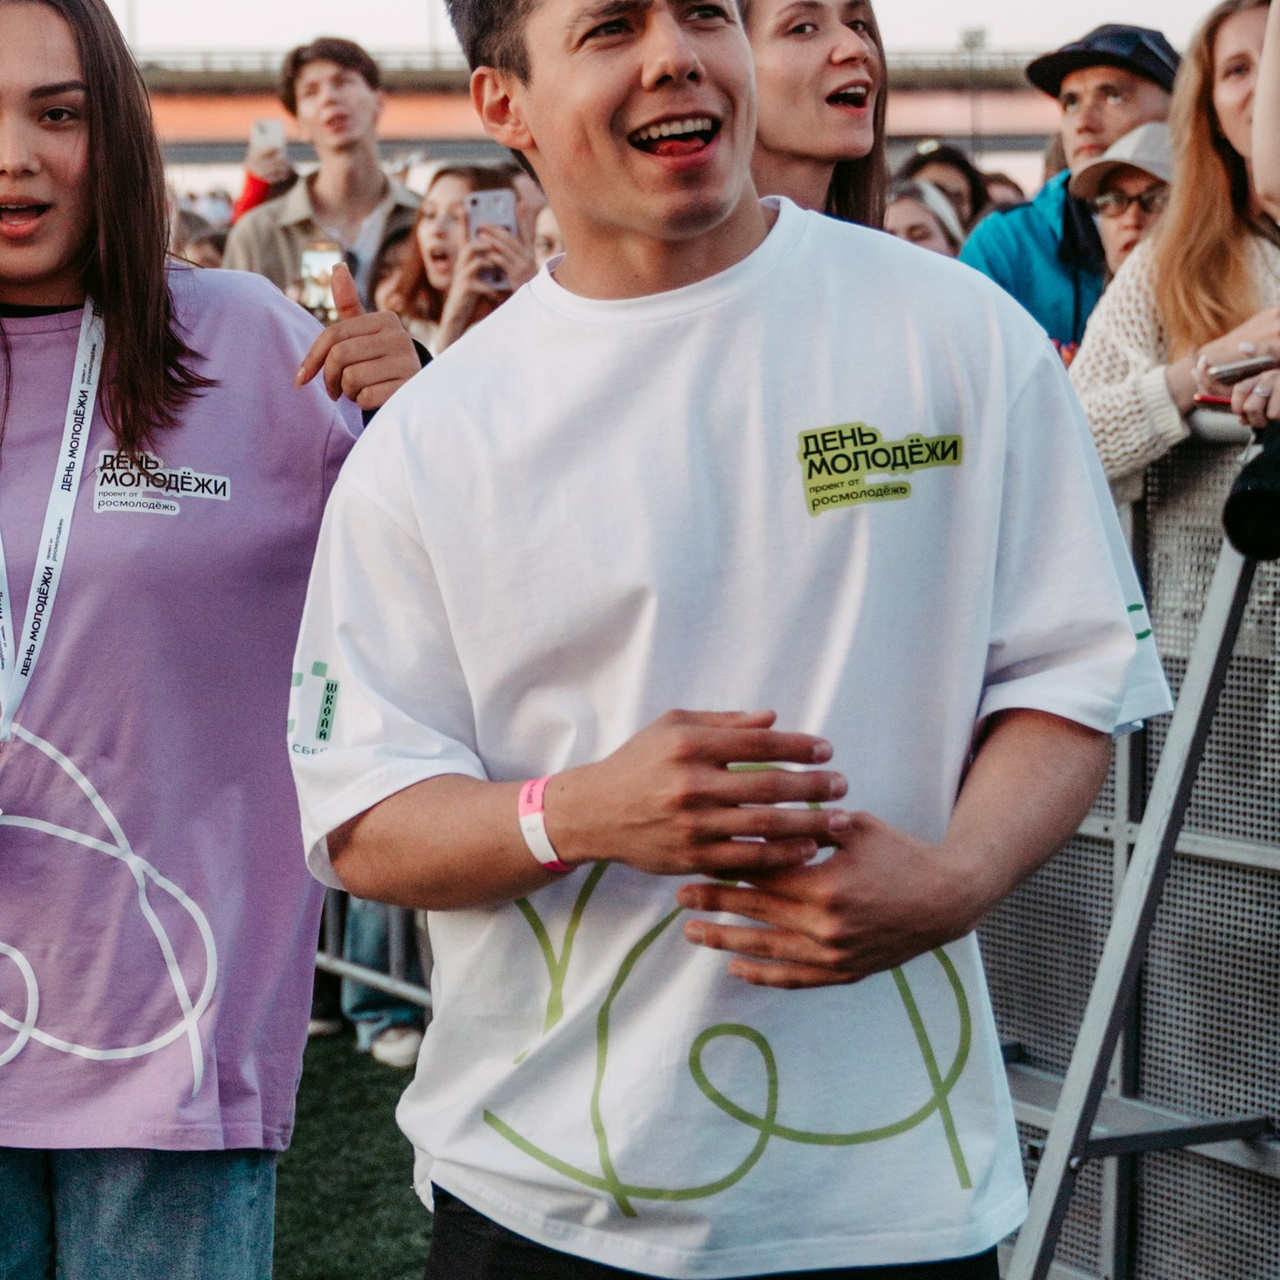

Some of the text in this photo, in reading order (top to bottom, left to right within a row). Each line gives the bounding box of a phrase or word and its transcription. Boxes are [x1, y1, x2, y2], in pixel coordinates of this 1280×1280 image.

[61, 389, 89, 492] ДЕНЬ МОЛОДЁЖИ
[803, 427, 878, 460] ДЕНЬ
[100, 454, 160, 472] ДЕНЬ
[807, 439, 958, 479] МОЛОДЁЖИ
[99, 472, 227, 496] МОЛОДЁЖИ
[809, 478, 860, 494] проект от
[811, 486, 908, 511] росмолодёжь
[98, 500, 177, 512] росмолодёжь
[20, 566, 54, 677] ДЕНЬ МОЛОДЁЖИ
[318, 682, 338, 740] ШКОЛА
